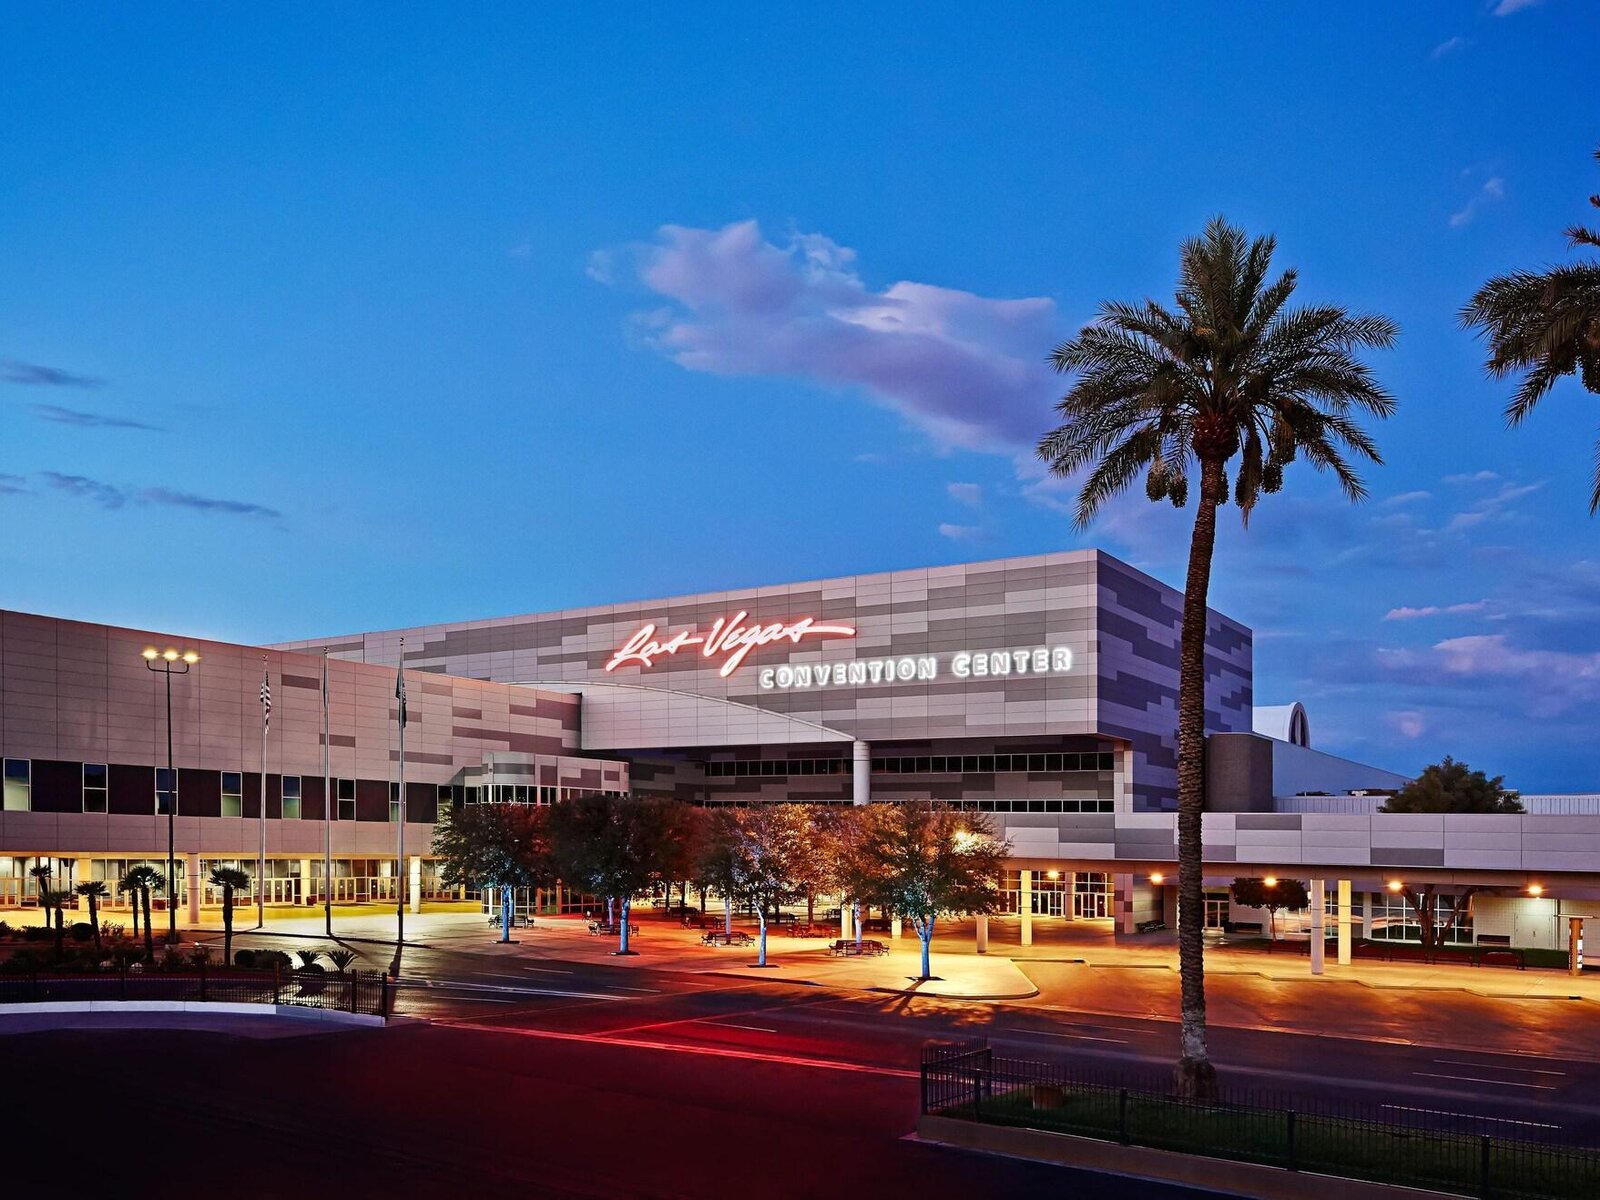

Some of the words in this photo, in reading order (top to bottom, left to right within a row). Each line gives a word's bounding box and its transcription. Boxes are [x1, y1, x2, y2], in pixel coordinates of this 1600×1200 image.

[606, 625, 702, 670] Las
[704, 611, 855, 677] Vegas
[759, 659, 937, 690] CONVENTION
[952, 647, 1072, 676] CENTER
